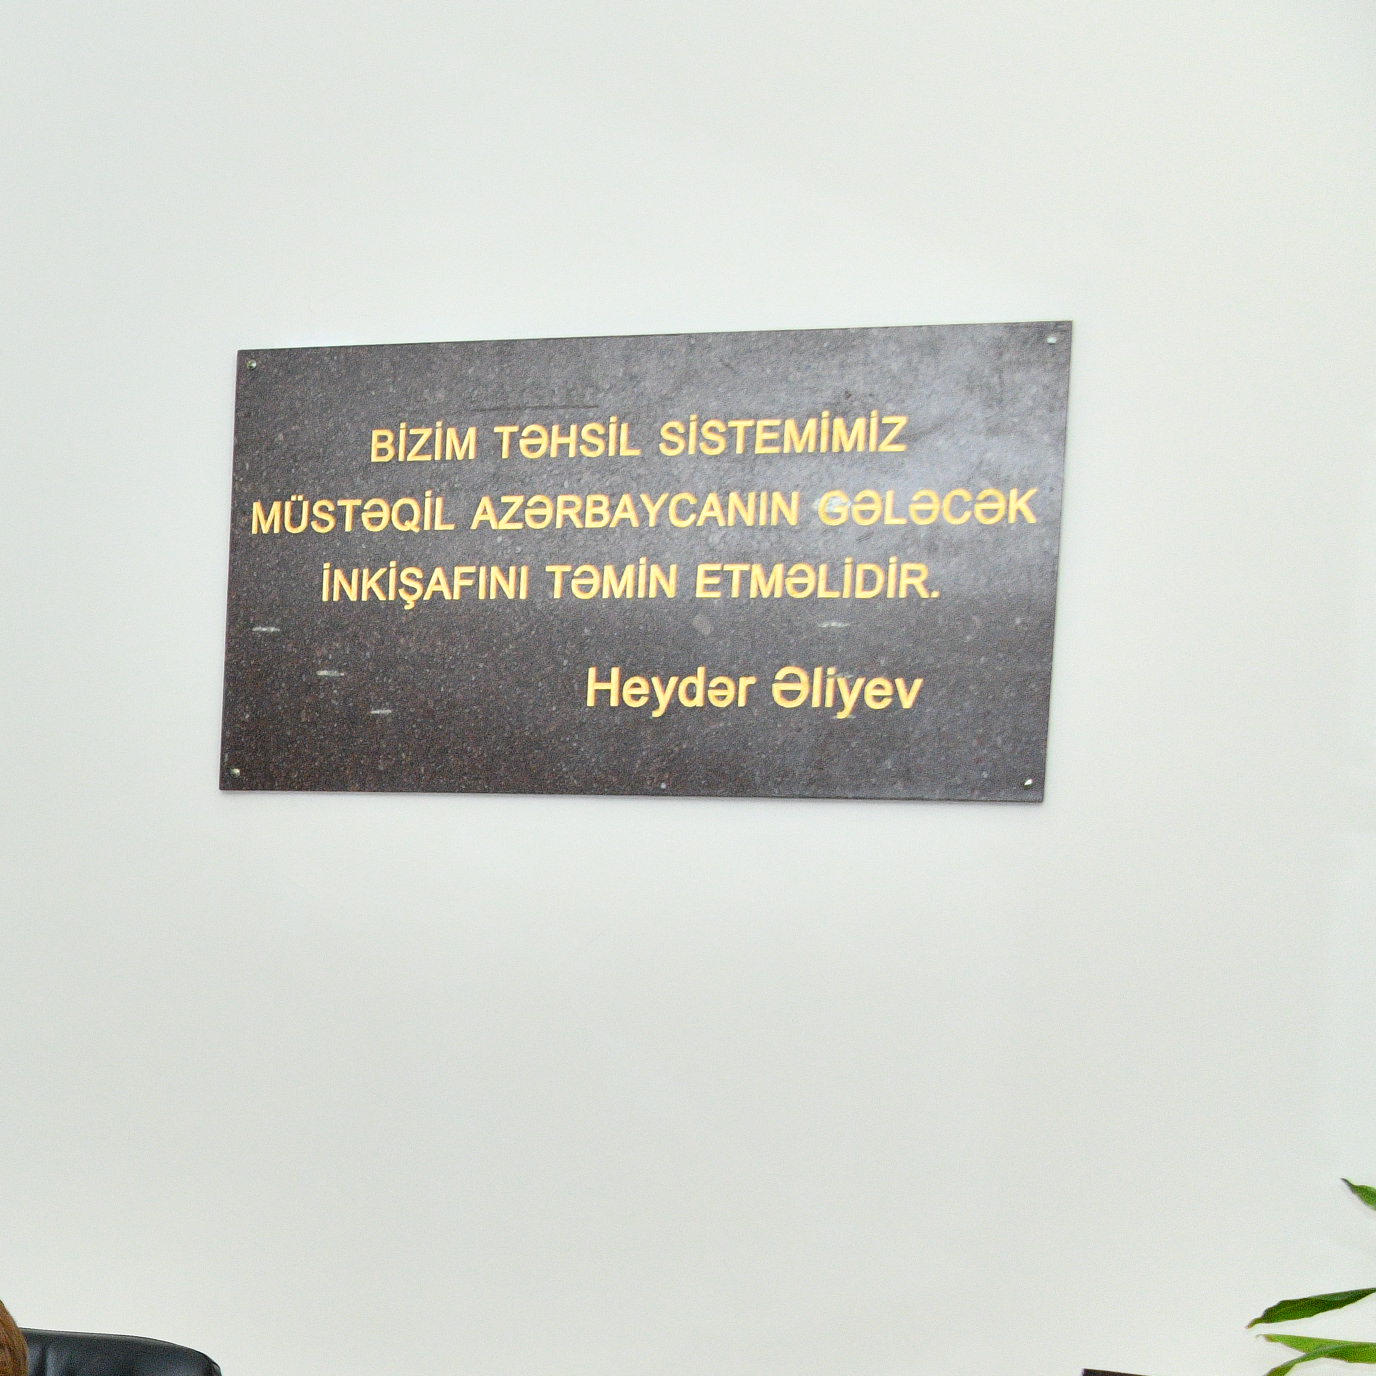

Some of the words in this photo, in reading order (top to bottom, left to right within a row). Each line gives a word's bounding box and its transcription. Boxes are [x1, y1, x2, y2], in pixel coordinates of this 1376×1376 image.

[370, 422, 479, 464] BİZİM
[494, 415, 643, 460] TƏHSİL
[659, 410, 910, 458] SİSTEMİMİZ
[251, 489, 457, 536] MÜSTƏQİL
[471, 490, 802, 531] AZƏRBAYCANIN
[817, 487, 1039, 527] GƏLƏCƏK
[322, 560, 531, 611] İNKİŞAFINI
[545, 557, 680, 602] TƏMİN
[695, 556, 942, 600] ETMƏLİDİR.
[586, 665, 759, 719] Heydər
[771, 664, 925, 720] Əliyev
